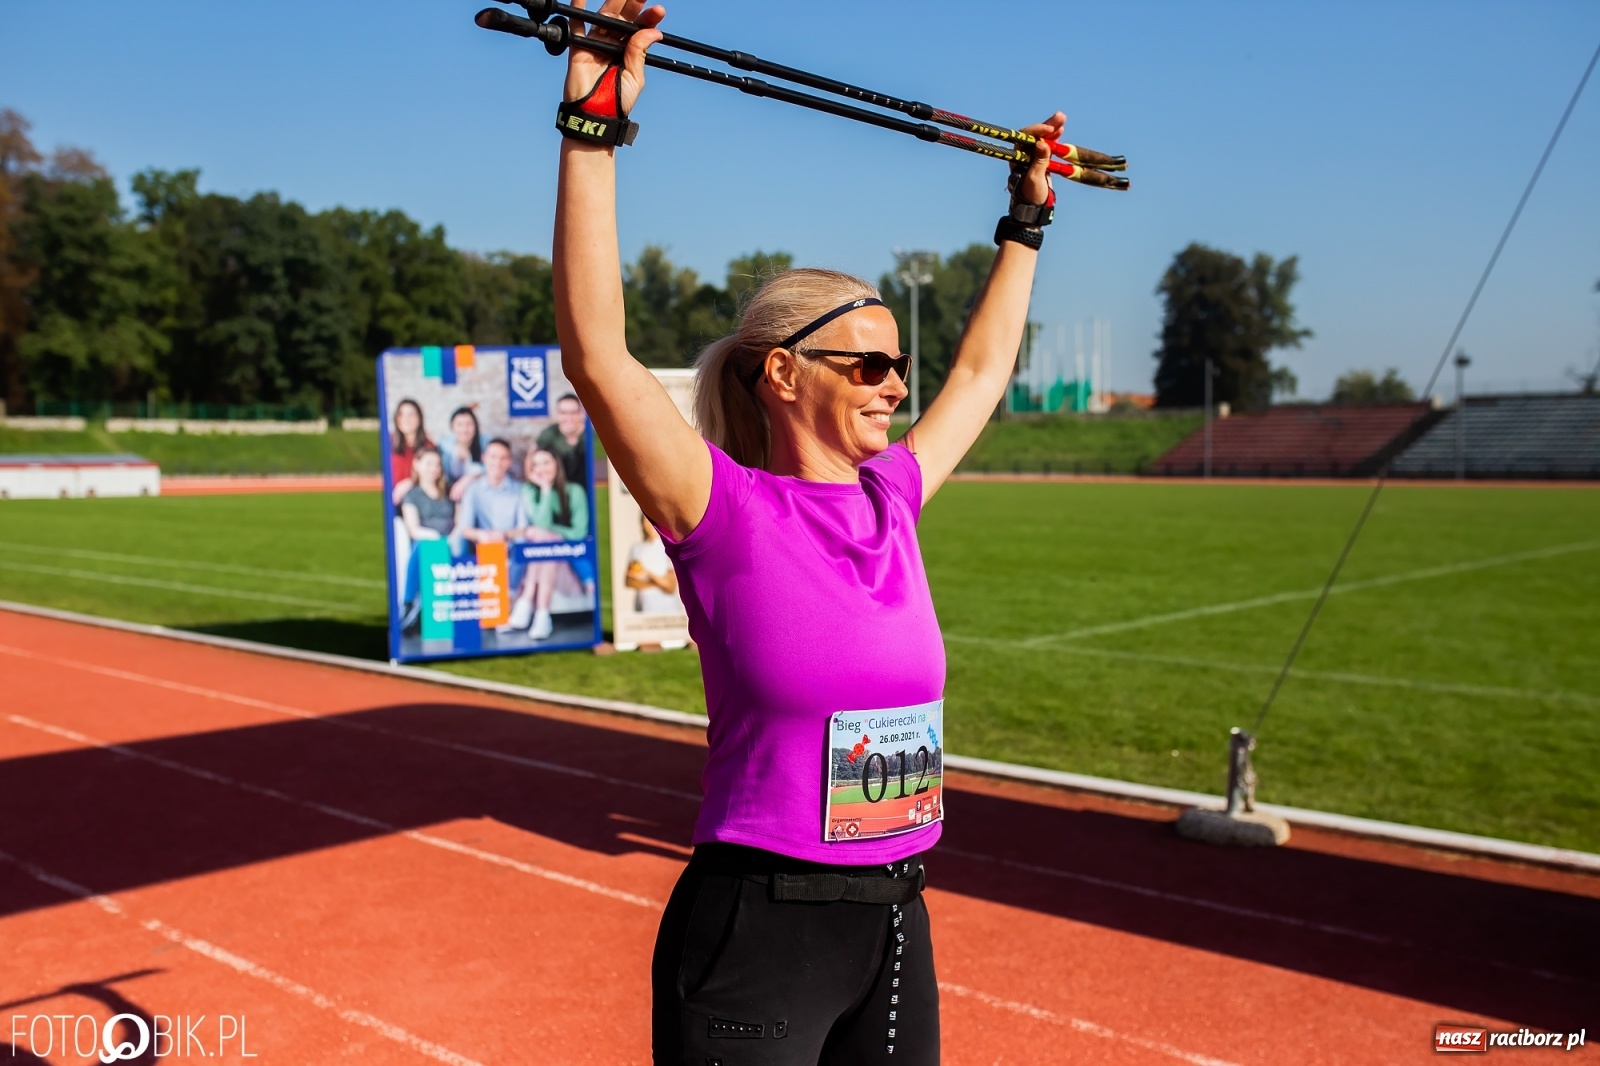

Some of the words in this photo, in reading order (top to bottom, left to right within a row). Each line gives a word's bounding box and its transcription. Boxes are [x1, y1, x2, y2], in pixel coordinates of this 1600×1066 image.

[557, 112, 607, 137] LEKI
[837, 720, 861, 733] Bieg
[917, 713, 926, 723] na
[879, 731, 915, 744] 26.09.2021
[915, 731, 921, 739] r.
[862, 745, 930, 804] 012
